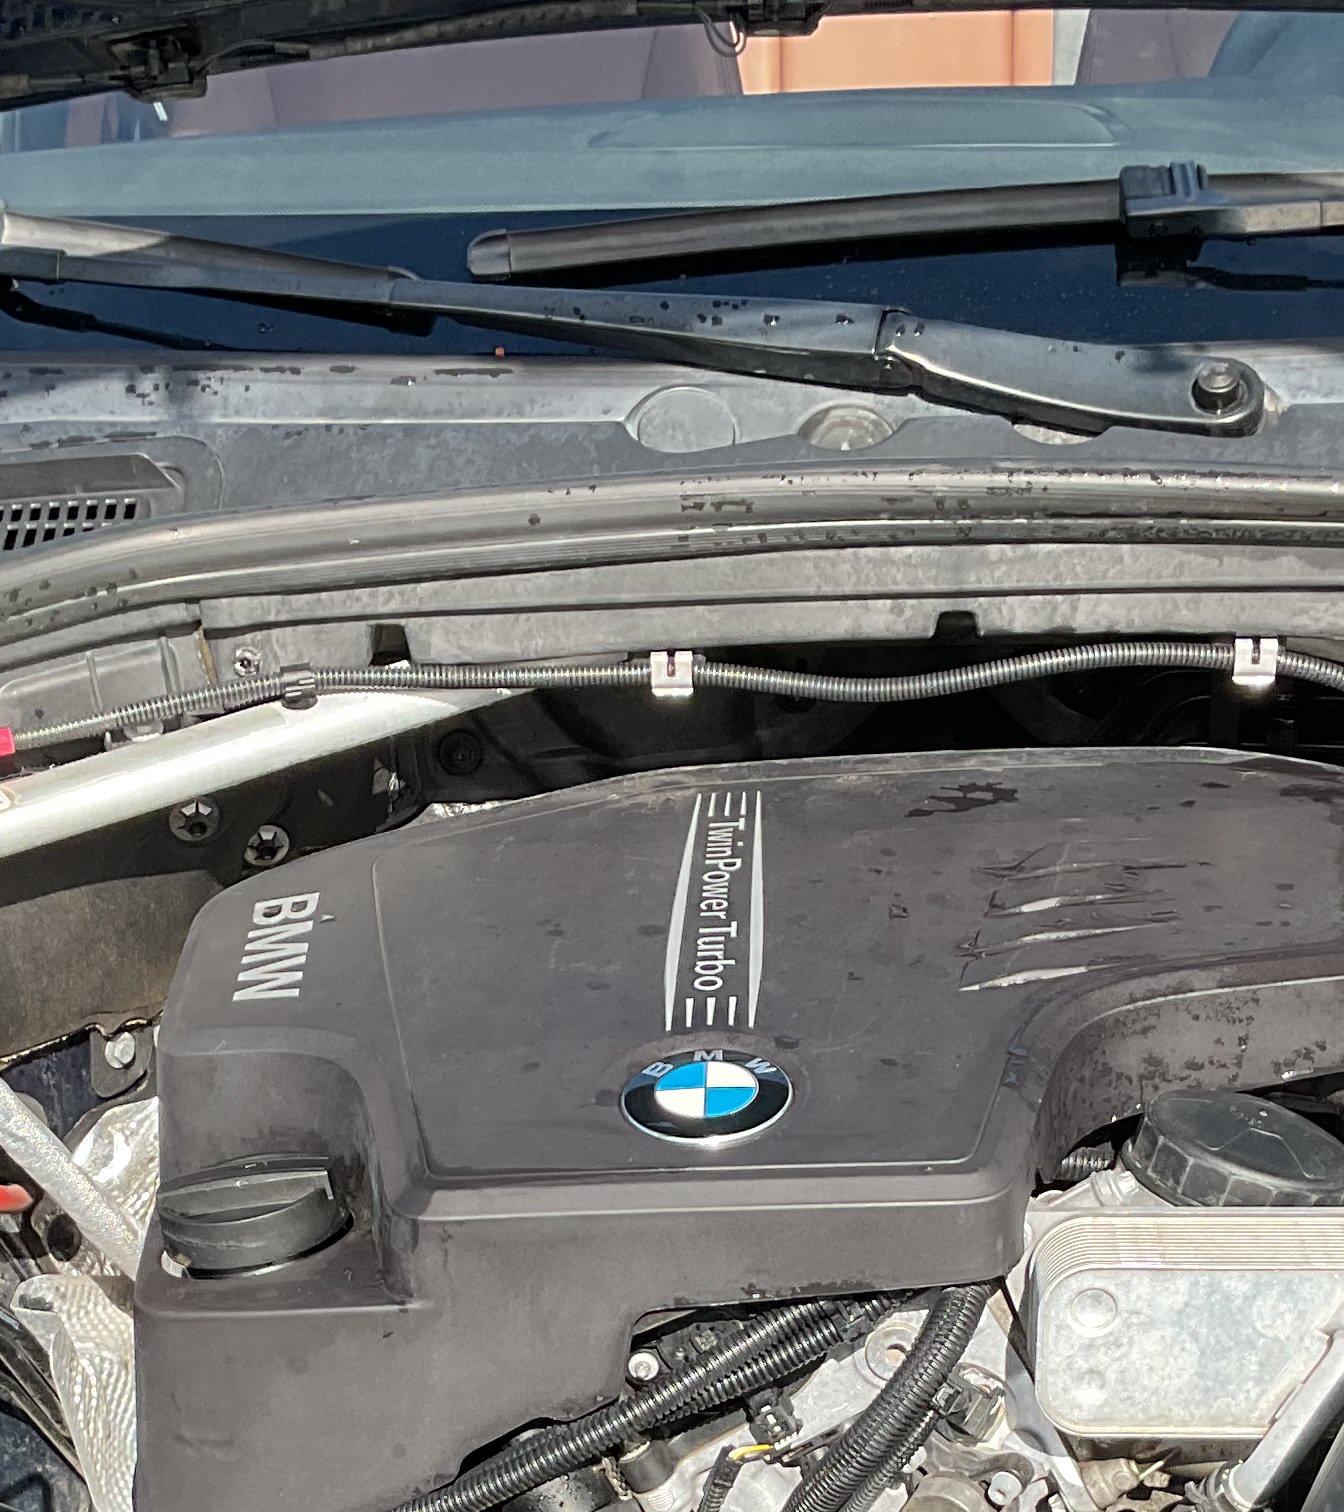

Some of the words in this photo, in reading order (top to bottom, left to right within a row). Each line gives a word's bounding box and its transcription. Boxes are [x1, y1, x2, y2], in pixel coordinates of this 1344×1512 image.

[699, 817, 746, 920] TwinPower
[232, 891, 320, 1002] BMW
[693, 921, 738, 991] Turbo
